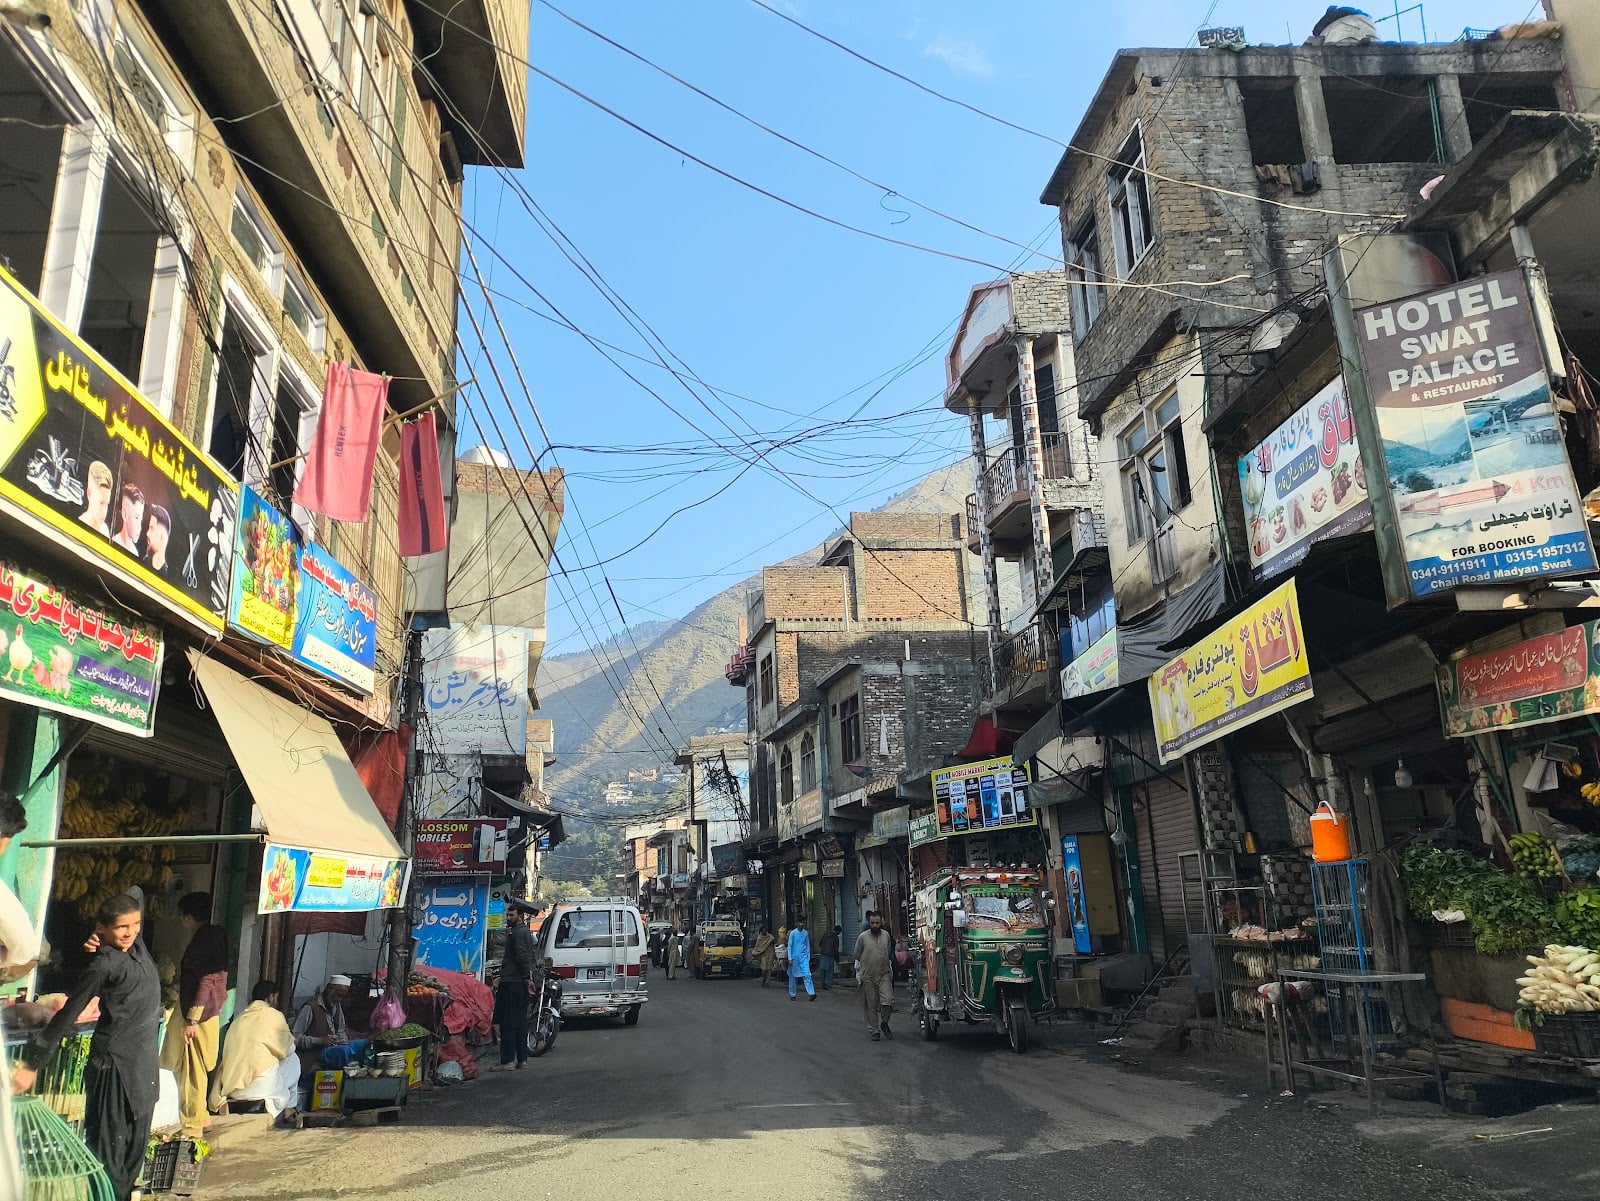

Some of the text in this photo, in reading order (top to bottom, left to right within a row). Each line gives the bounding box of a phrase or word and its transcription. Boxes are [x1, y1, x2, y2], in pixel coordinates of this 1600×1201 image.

[1363, 279, 1518, 341] HOTEL
[1400, 319, 1491, 360] SWAT
[1388, 342, 1520, 392] PALACE
[1411, 373, 1505, 402] & RESTAURANT
[1479, 508, 1529, 533] مچھلی
[1411, 541, 1587, 580] 0341-9111911 0315-1957312
[1452, 535, 1536, 558] FOR BOOKING
[1461, 571, 1491, 586] Road
[1494, 563, 1540, 581] Madyan
[1542, 557, 1573, 571] Swat
[1239, 596, 1301, 697] اتفاق
